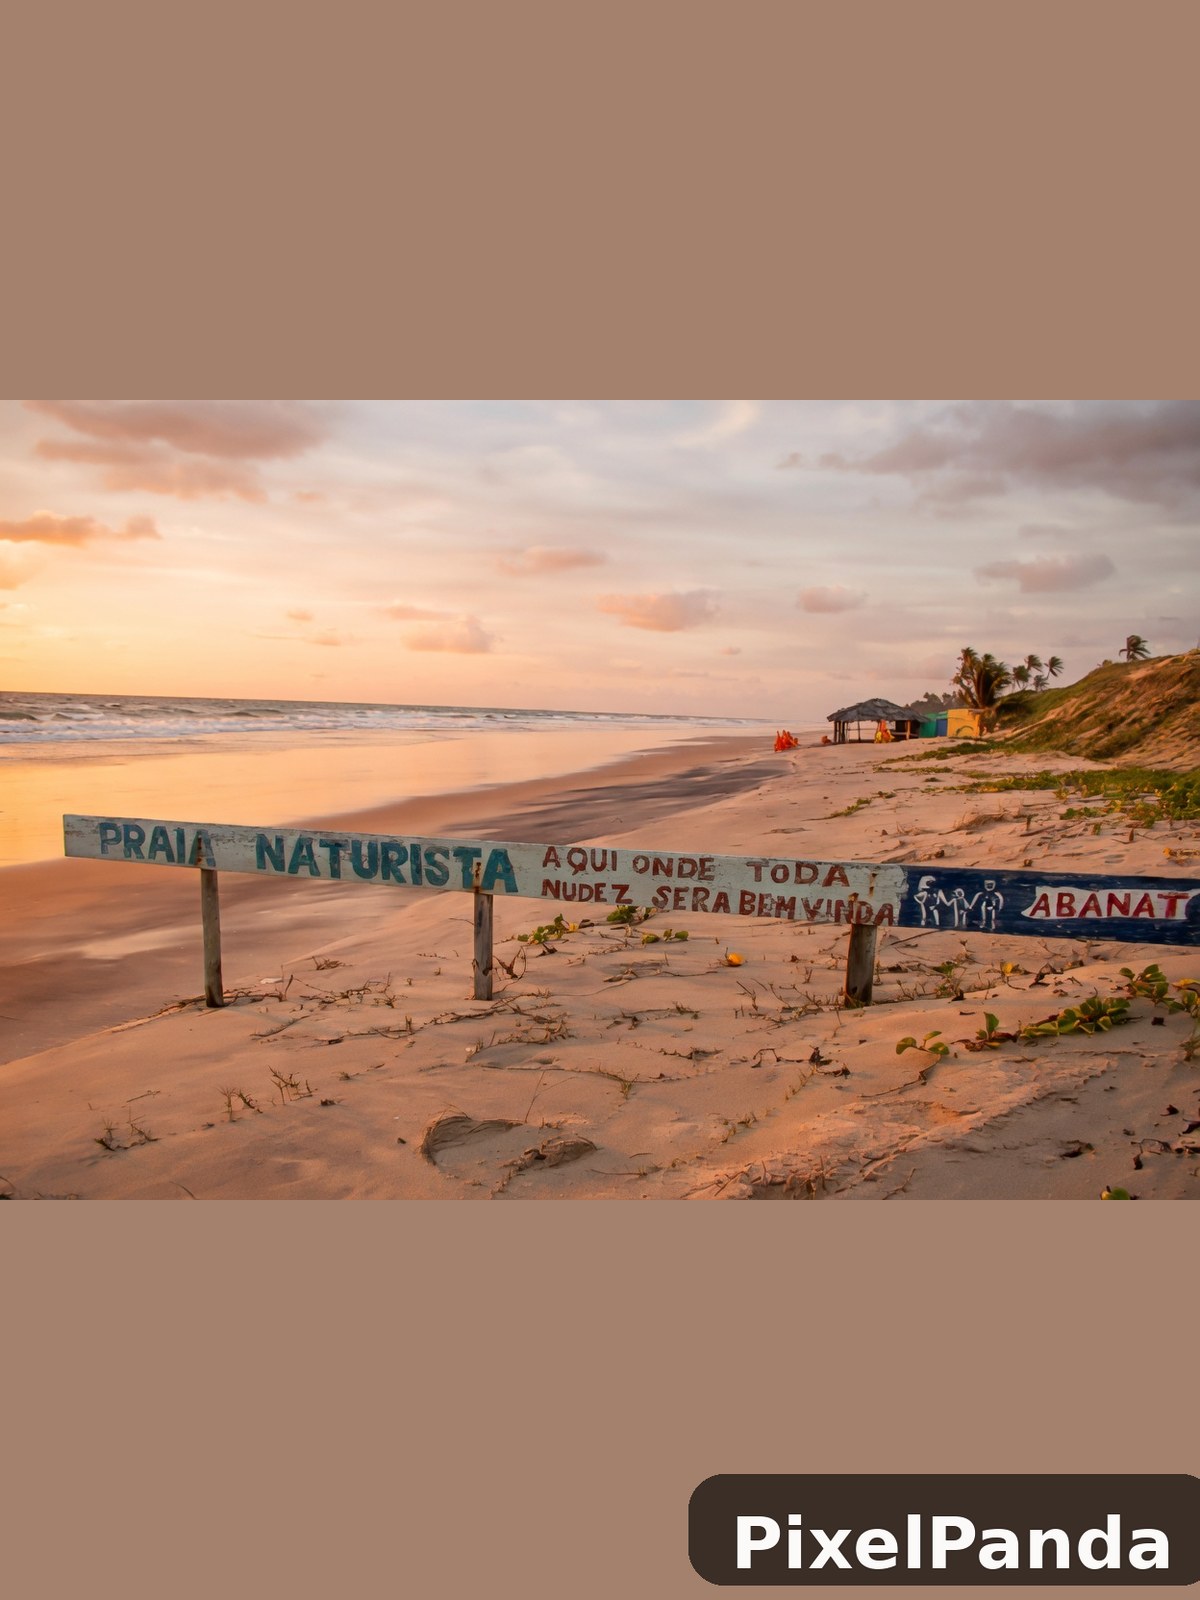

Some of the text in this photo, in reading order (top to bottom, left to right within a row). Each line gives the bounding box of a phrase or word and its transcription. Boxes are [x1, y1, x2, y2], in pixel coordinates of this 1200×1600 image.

[99, 822, 519, 893] PRAIA NATURISTA
[542, 846, 850, 887] AQUI ONDE TODA
[541, 879, 633, 905] NUDEZ
[651, 885, 731, 914] SERA
